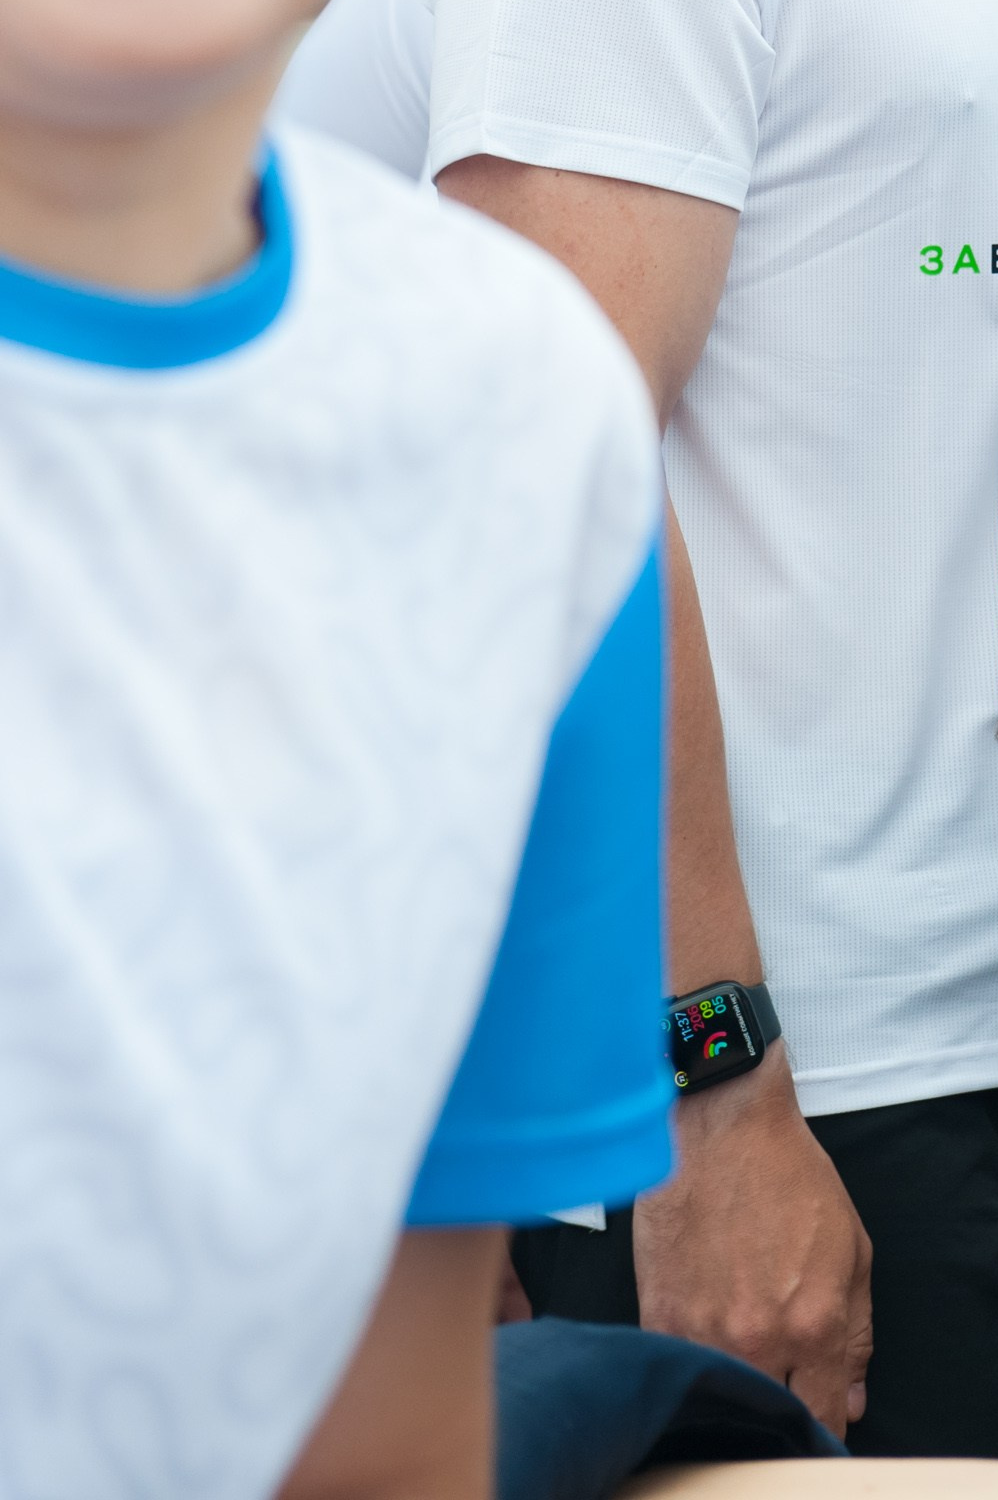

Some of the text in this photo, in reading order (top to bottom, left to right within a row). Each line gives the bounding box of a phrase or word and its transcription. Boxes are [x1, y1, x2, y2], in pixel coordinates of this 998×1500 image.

[699, 1000, 714, 1019] 09
[711, 995, 727, 1014] 05
[674, 1012, 695, 1042] 11:37
[687, 1005, 705, 1032] 206
